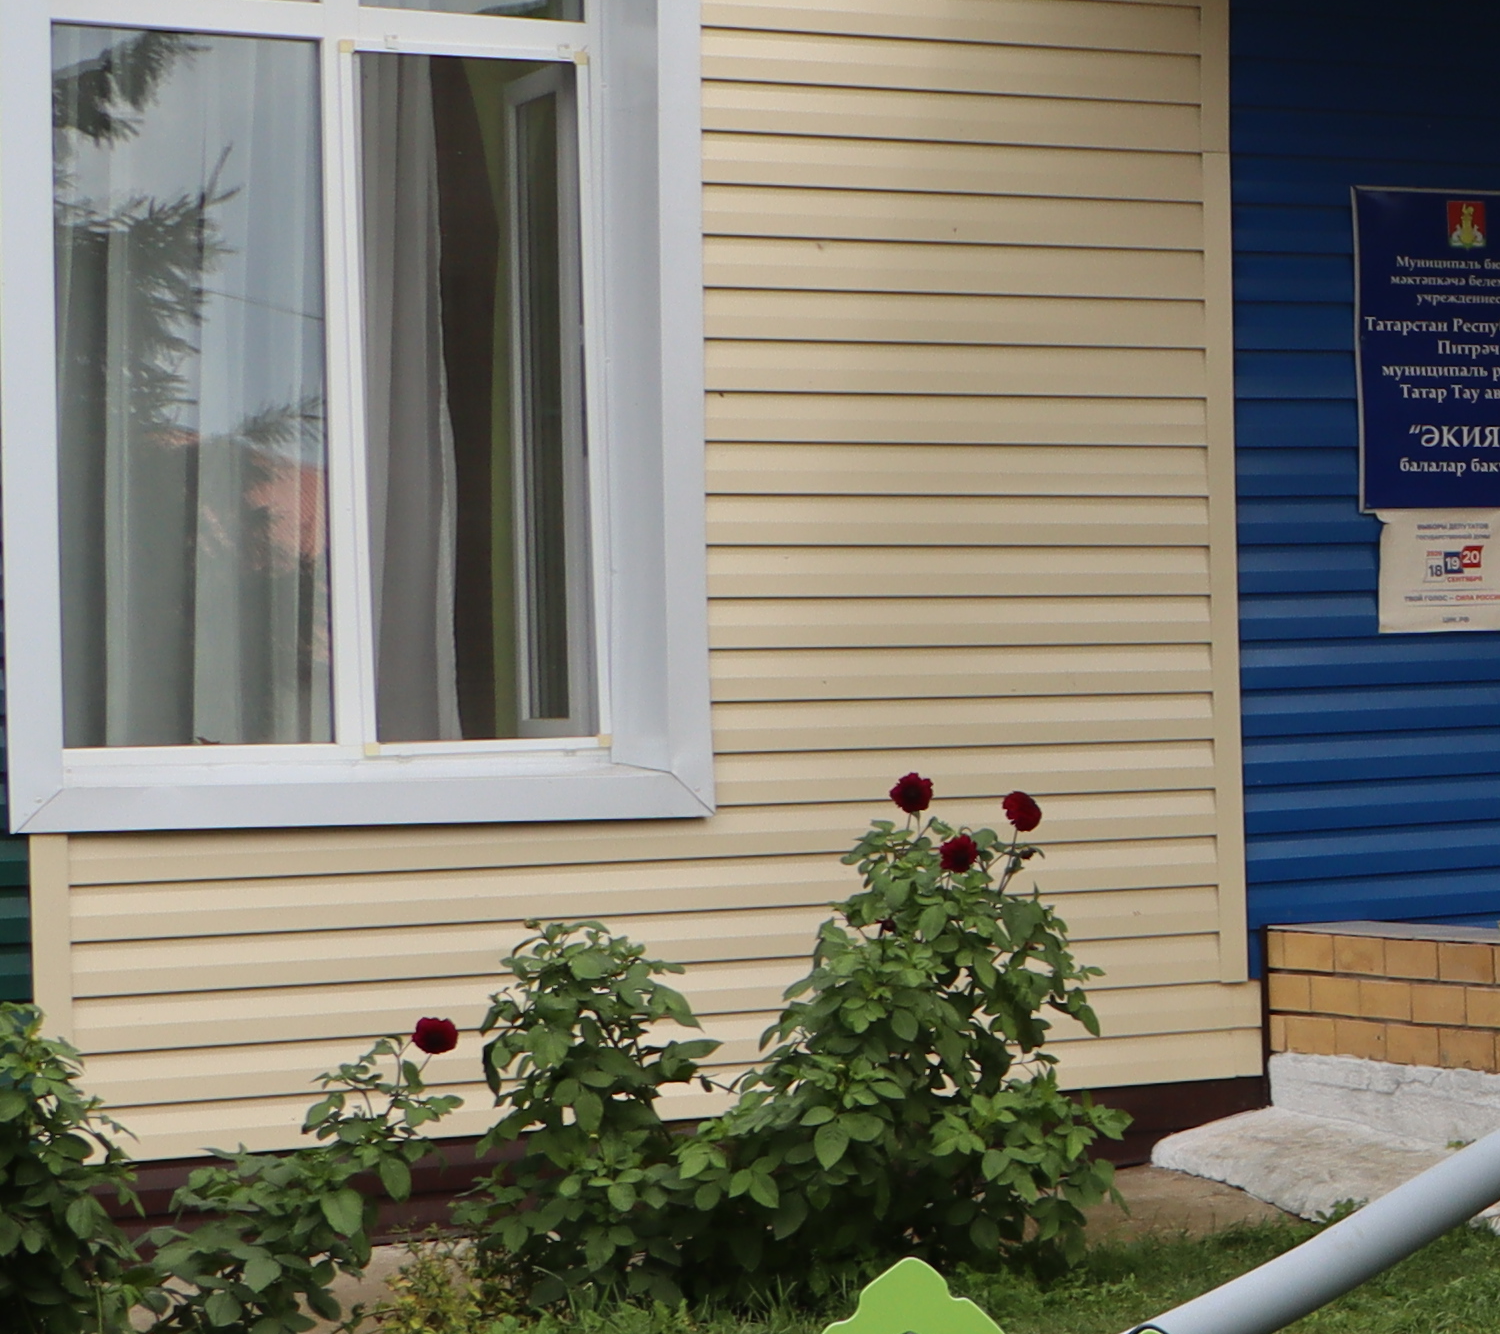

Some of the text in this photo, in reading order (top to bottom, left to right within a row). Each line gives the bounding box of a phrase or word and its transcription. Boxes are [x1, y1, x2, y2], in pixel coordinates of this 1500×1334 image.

[1396, 255, 1482, 272] Муниципаль
[1390, 276, 1466, 287] мәктәпкәчә
[1365, 316, 1448, 336] Татарстан
[1437, 340, 1500, 359] Питрәч
[1382, 364, 1488, 380] муниципаль
[1399, 384, 1448, 403] Татар
[1451, 385, 1480, 403] Тау
[1399, 458, 1467, 476] балалар
[1429, 551, 1480, 577] 18 19 20
